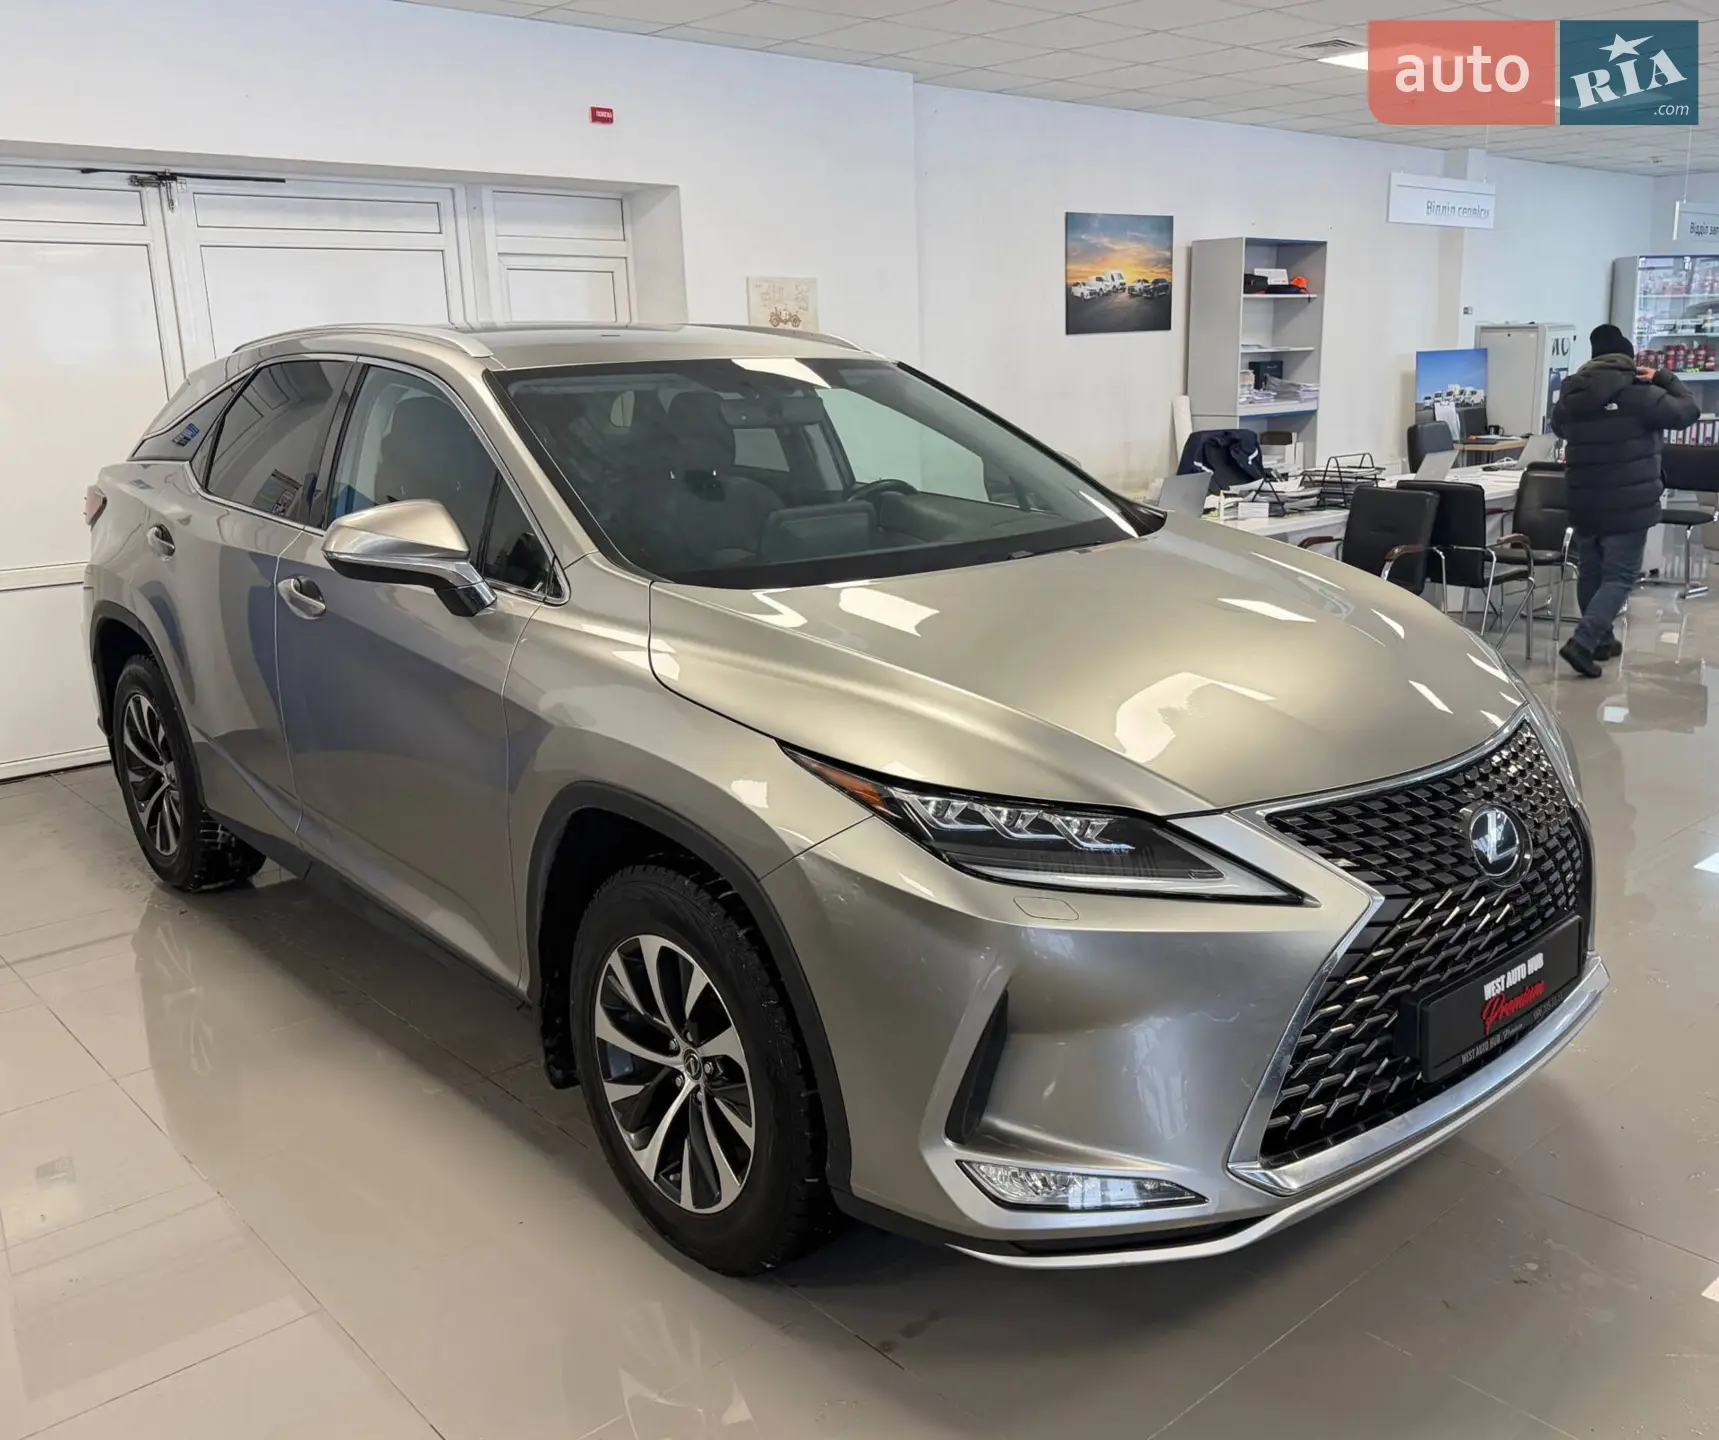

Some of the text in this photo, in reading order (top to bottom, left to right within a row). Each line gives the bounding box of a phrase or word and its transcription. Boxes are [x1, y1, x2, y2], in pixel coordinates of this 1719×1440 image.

[1483, 952, 1544, 1001] WEST AUTO HUB
